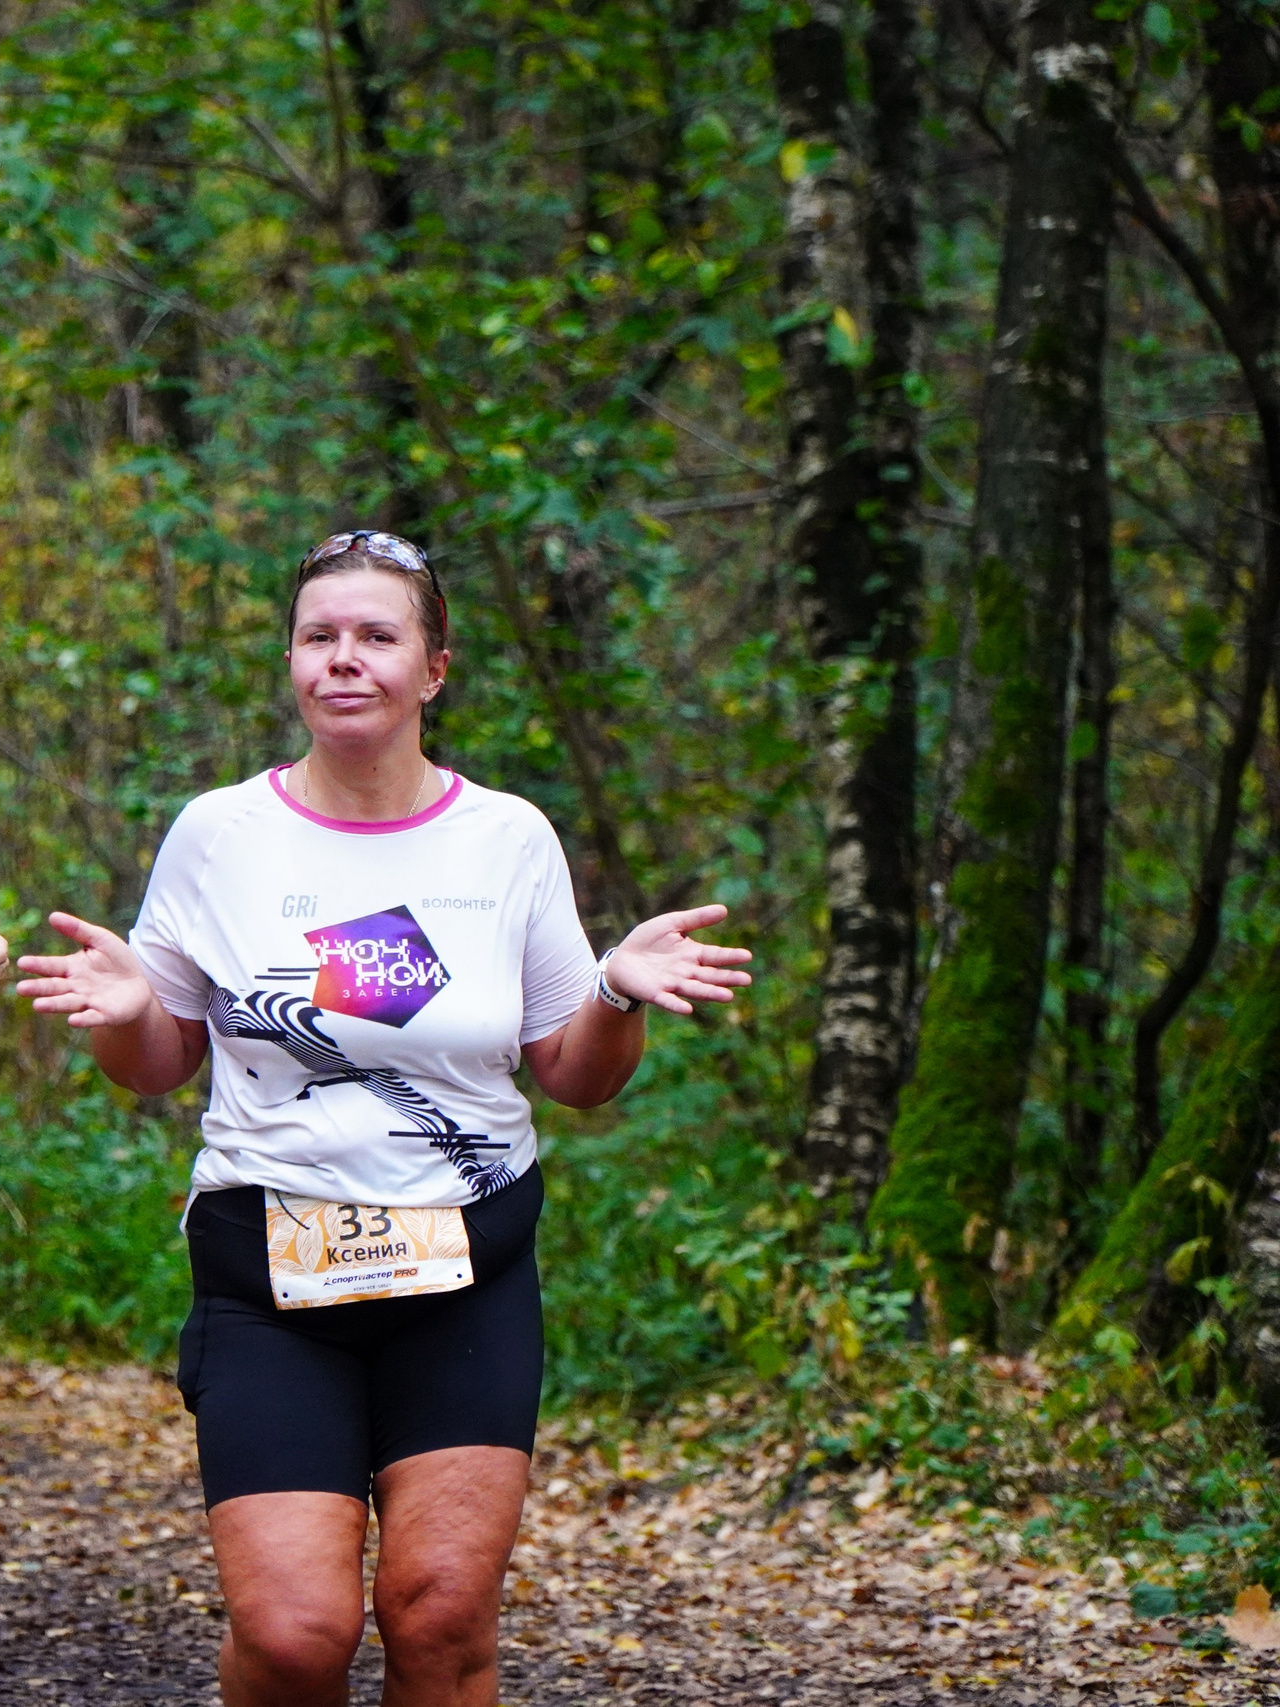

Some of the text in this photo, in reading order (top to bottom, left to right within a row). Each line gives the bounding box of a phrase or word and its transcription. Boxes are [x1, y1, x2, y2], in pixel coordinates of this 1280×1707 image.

[422, 897, 497, 910] ВОЛОНТЁР
[342, 987, 414, 999] ЗАБЕГ
[338, 1204, 392, 1241] 33
[327, 1243, 407, 1264] Ксения
[394, 1268, 418, 1278] PRO
